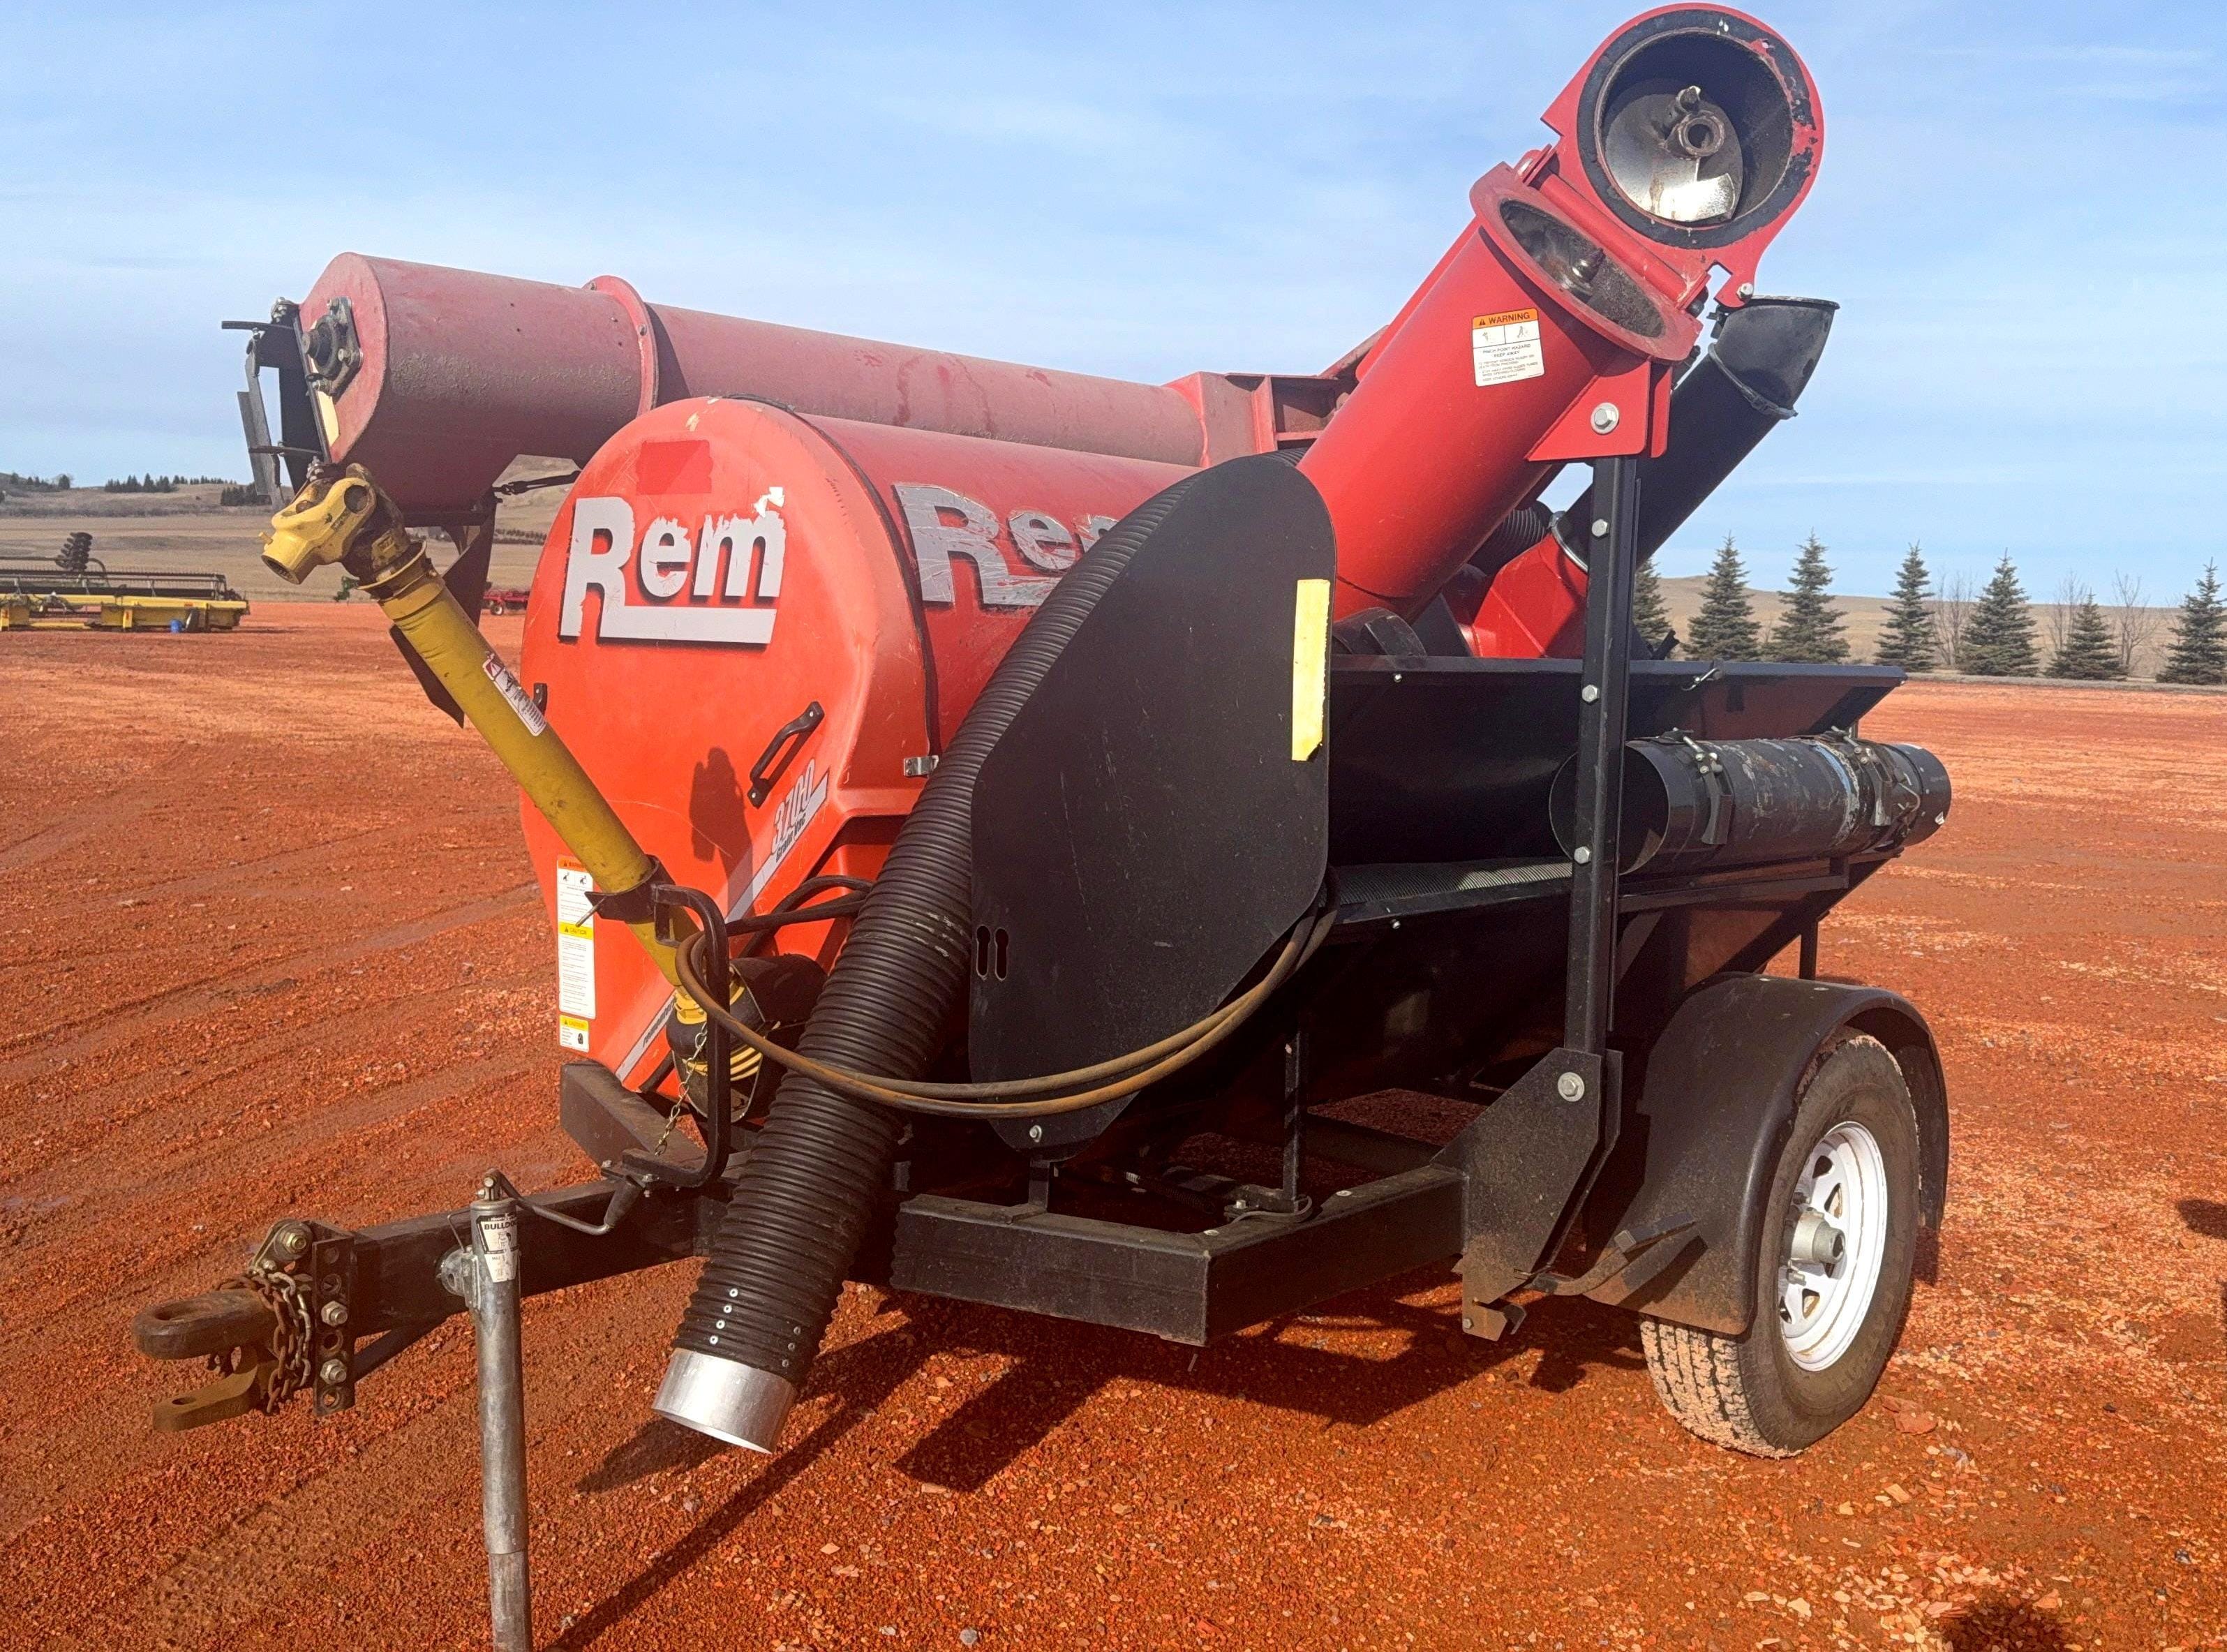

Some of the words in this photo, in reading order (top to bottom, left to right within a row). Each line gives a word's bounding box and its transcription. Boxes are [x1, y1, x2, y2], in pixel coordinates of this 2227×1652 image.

[1489, 312, 1530, 325] WARNING
[560, 489, 787, 644] Rem
[771, 758, 814, 854] 3700
